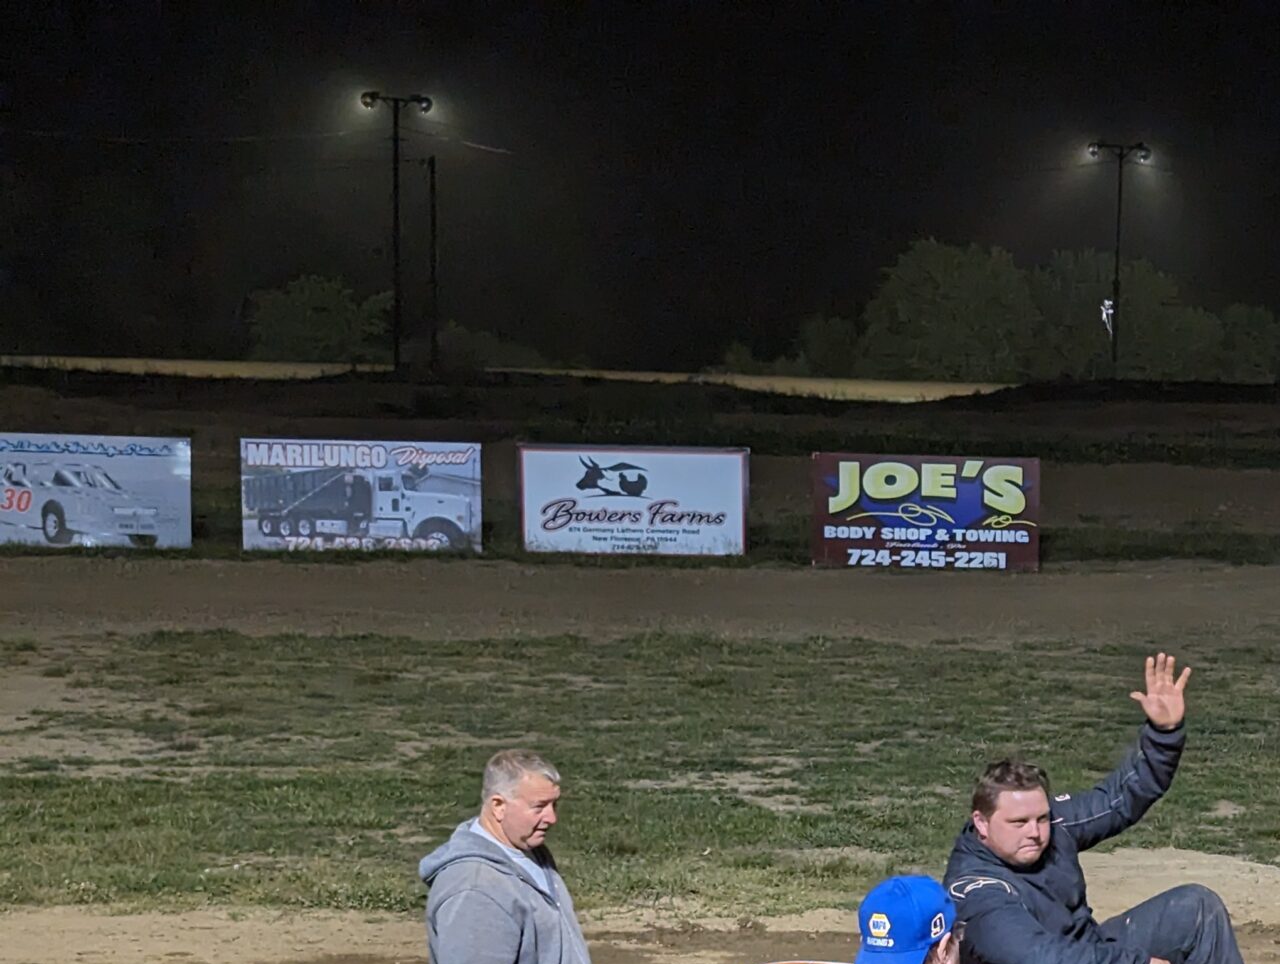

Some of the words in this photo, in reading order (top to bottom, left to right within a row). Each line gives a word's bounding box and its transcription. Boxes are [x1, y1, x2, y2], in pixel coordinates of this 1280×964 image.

[246, 443, 387, 468] MARILUNGO
[391, 445, 474, 468] Disposal
[829, 460, 1026, 515] JOE'S
[541, 499, 641, 531] Bowers
[648, 500, 726, 527] Farms
[824, 525, 875, 539] BODY
[881, 527, 933, 541] SHOP
[935, 529, 950, 541] &
[952, 529, 1029, 543] TOWING
[847, 549, 1006, 569] 724-245-2261
